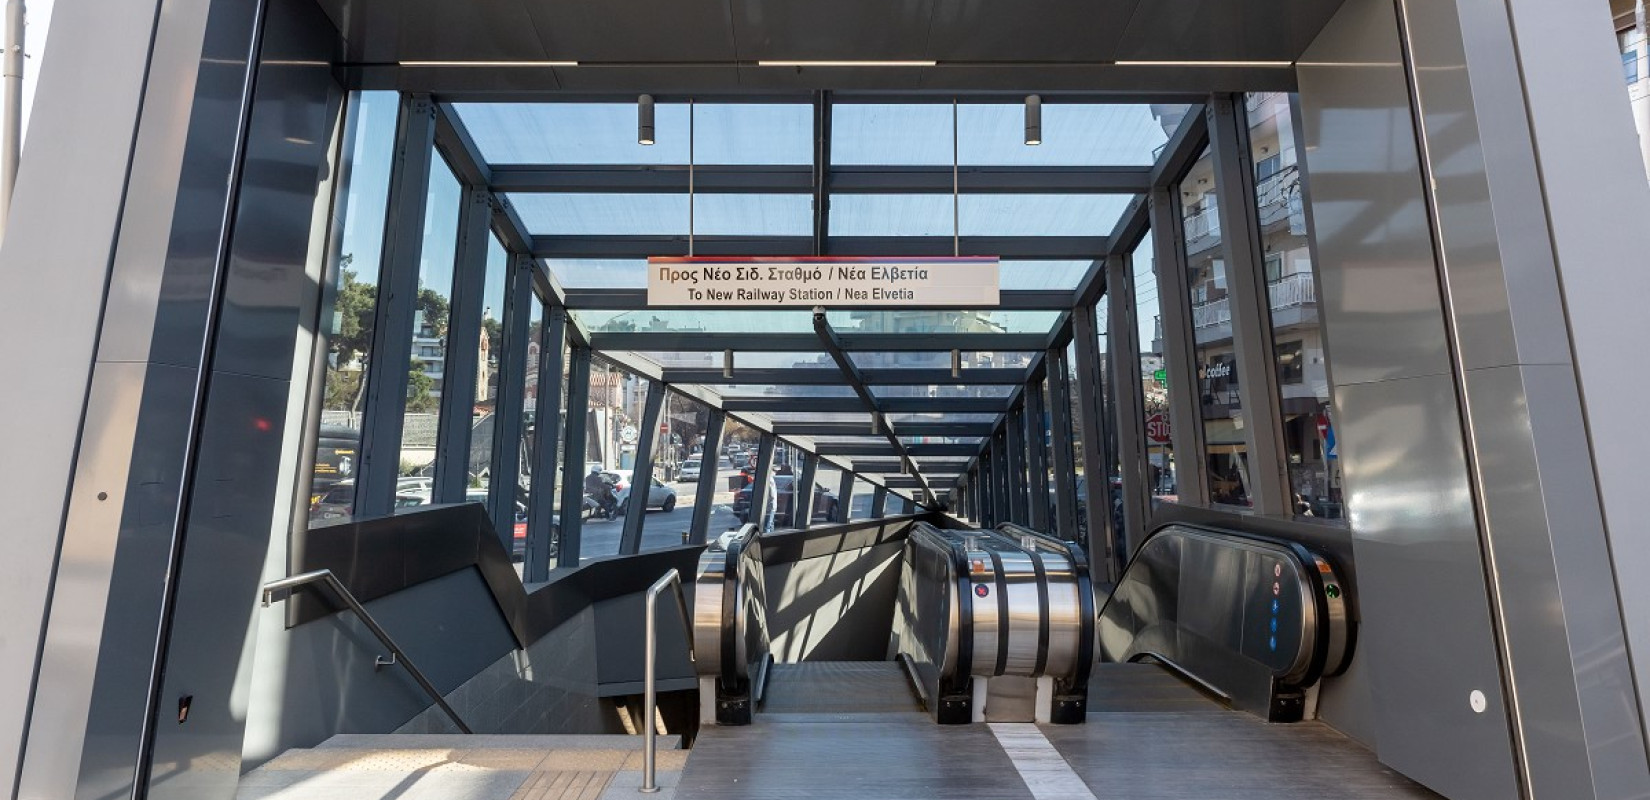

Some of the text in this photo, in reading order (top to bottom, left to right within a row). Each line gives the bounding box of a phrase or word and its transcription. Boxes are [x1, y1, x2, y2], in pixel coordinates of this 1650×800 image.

[659, 266, 928, 284] Προς Νέο Σιδ. Σταθμό / Νέα Ελβετία
[688, 288, 914, 303] To New Railway Station / Nea Elvetia
[1147, 421, 1171, 437] STO
